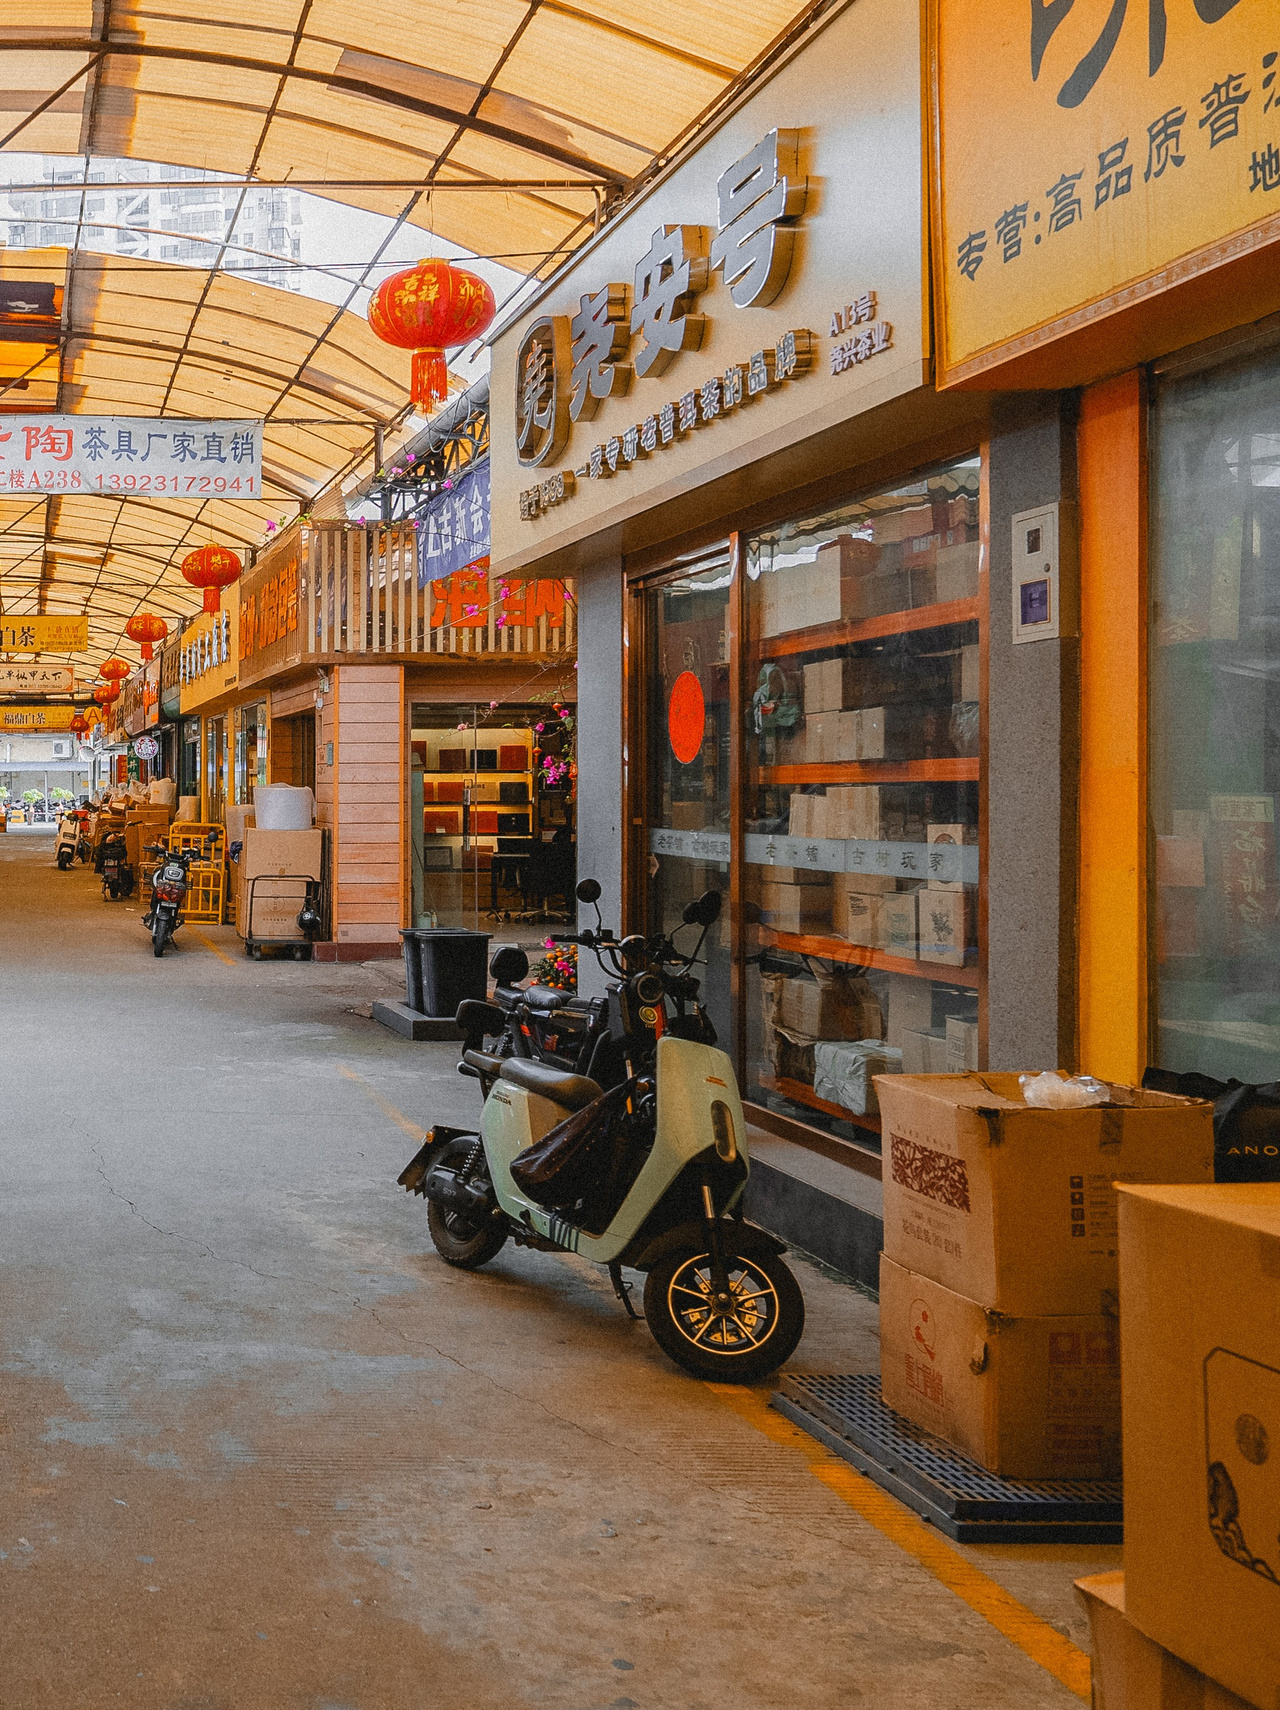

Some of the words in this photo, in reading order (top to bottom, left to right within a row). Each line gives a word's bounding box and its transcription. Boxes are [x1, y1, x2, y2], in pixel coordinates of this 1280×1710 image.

[570, 127, 800, 422] 尧安号
[828, 290, 877, 338] A13号
[81, 425, 256, 465] 茶具厂家直销
[94, 473, 256, 493] 13923172941
[4, 712, 47, 725] 福鼎白茶
[87, 708, 101, 722] A
